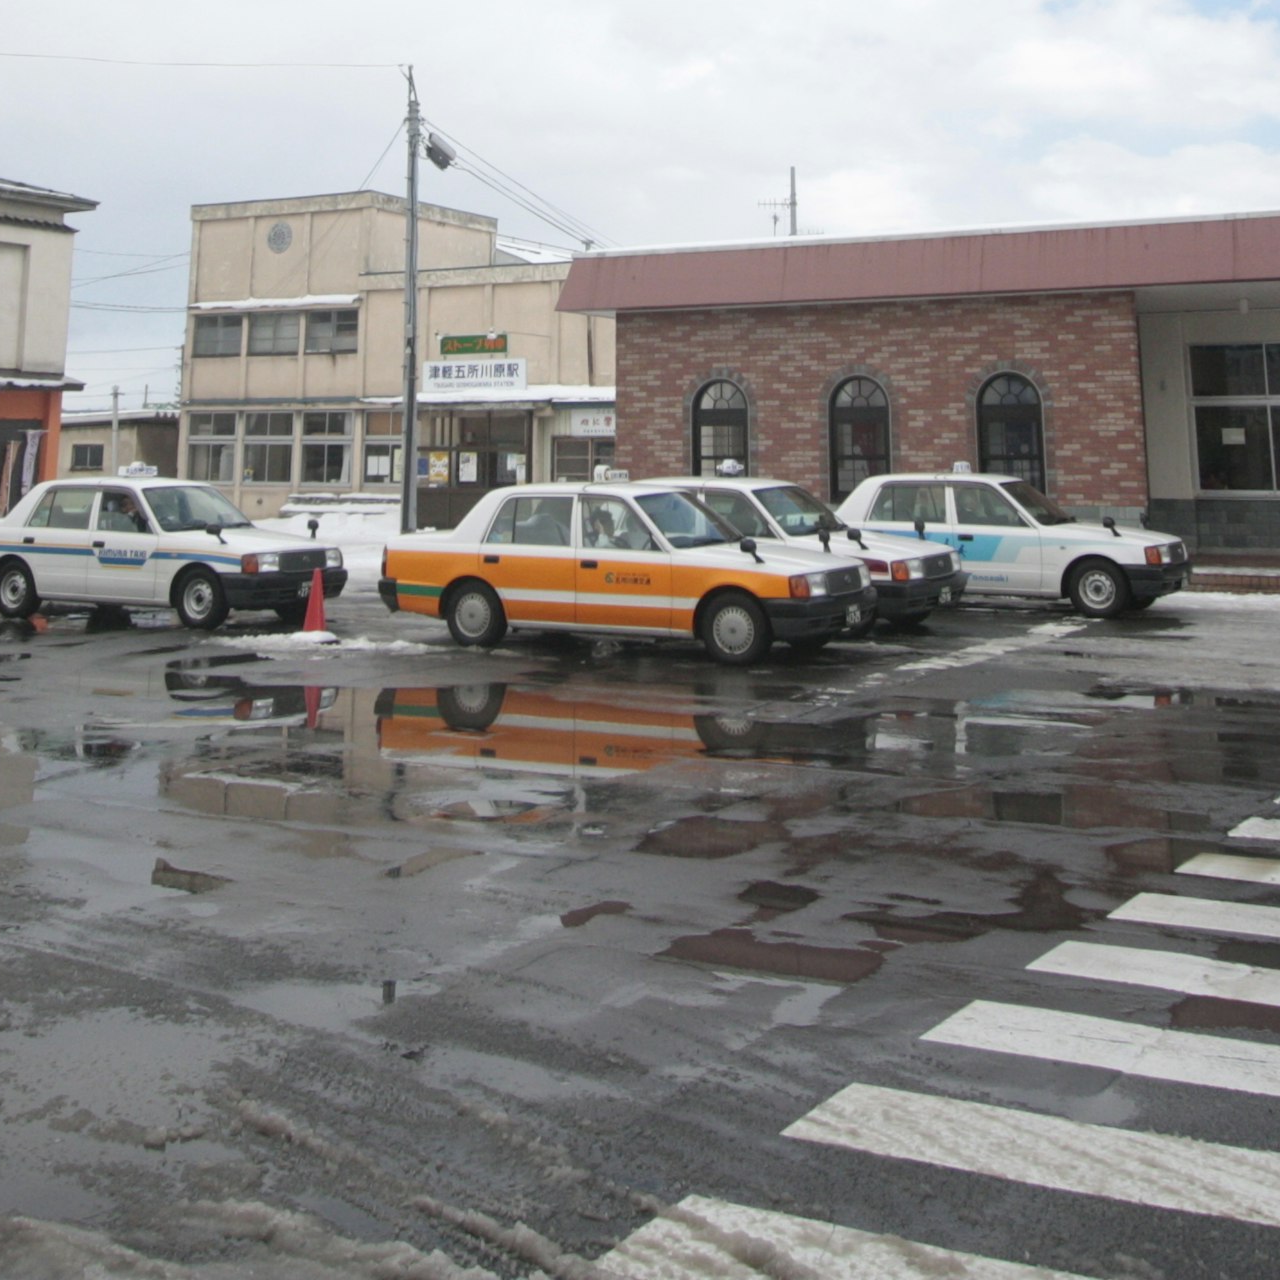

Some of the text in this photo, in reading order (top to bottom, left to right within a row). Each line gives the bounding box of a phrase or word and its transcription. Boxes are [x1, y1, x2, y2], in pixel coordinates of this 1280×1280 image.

[428, 362, 520, 380] 津軽五所川原駅
[129, 549, 147, 559] TAXI
